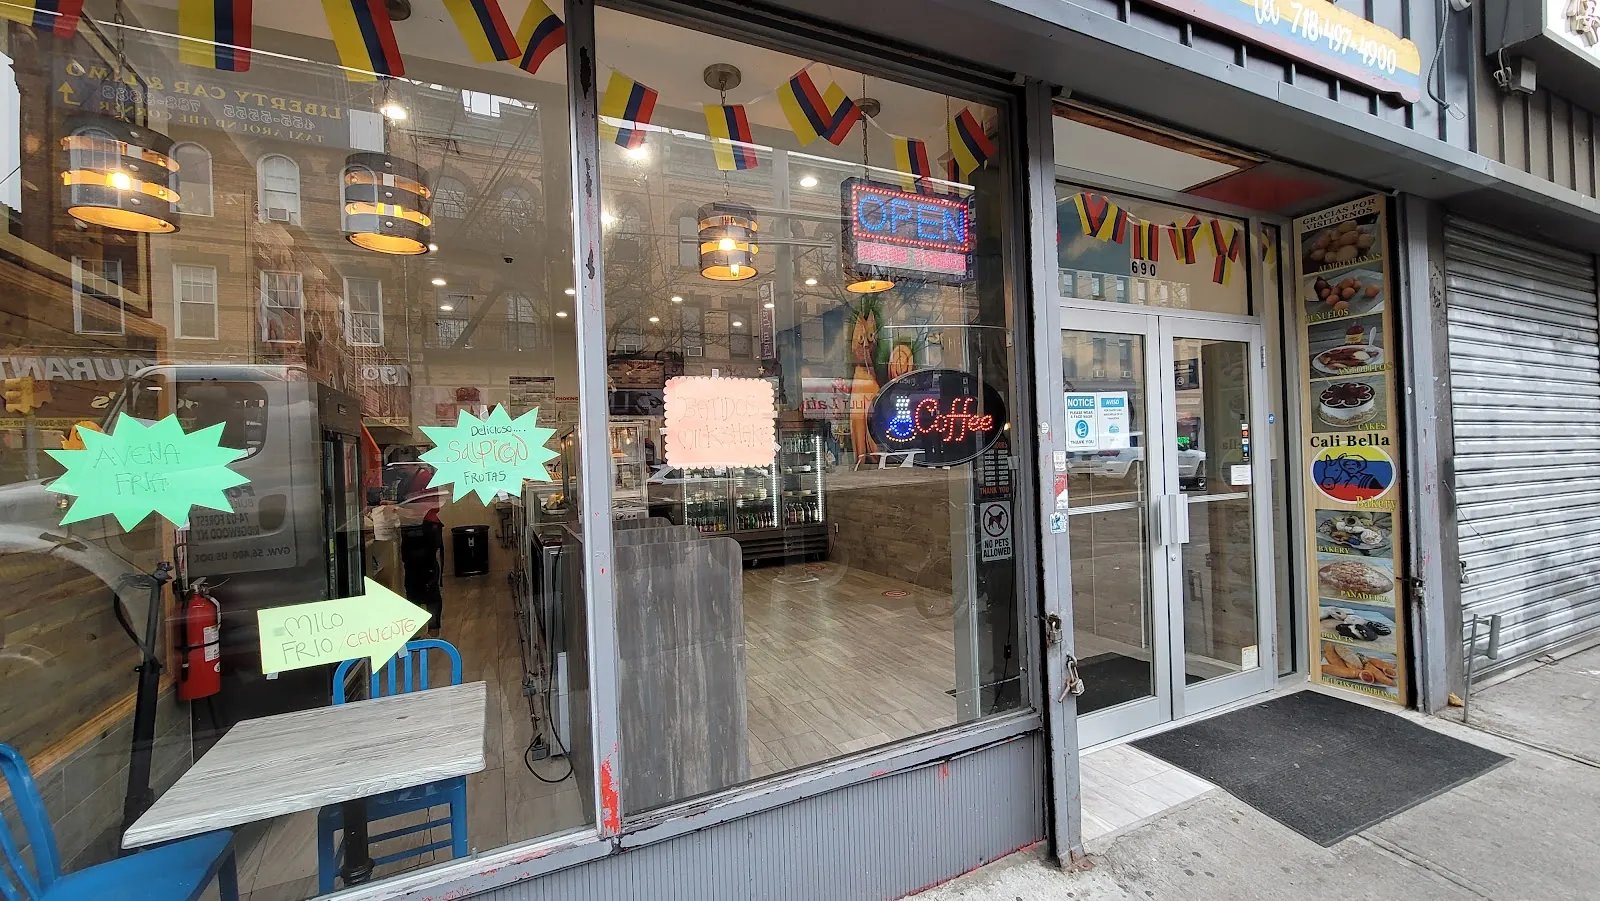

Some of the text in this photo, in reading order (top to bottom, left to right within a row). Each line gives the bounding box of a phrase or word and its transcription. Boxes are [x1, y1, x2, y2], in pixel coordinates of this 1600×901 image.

[858, 194, 966, 243] OPEN
[1302, 198, 1376, 225] GRACIAS POR
[1306, 206, 1373, 231] VISITARNOS
[1131, 261, 1156, 276] 690
[1067, 398, 1094, 407] NOTICE
[915, 397, 993, 442] Coffee
[1358, 423, 1386, 431] CAKES
[1310, 434, 1390, 447] Cali Bella
[92, 441, 181, 468] AVENA
[1355, 495, 1397, 512] Bakery
[984, 539, 1009, 548] NO PETS
[1317, 546, 1350, 554] BAKERY
[983, 547, 1011, 558] ALLOWED
[284, 612, 344, 637] MILO
